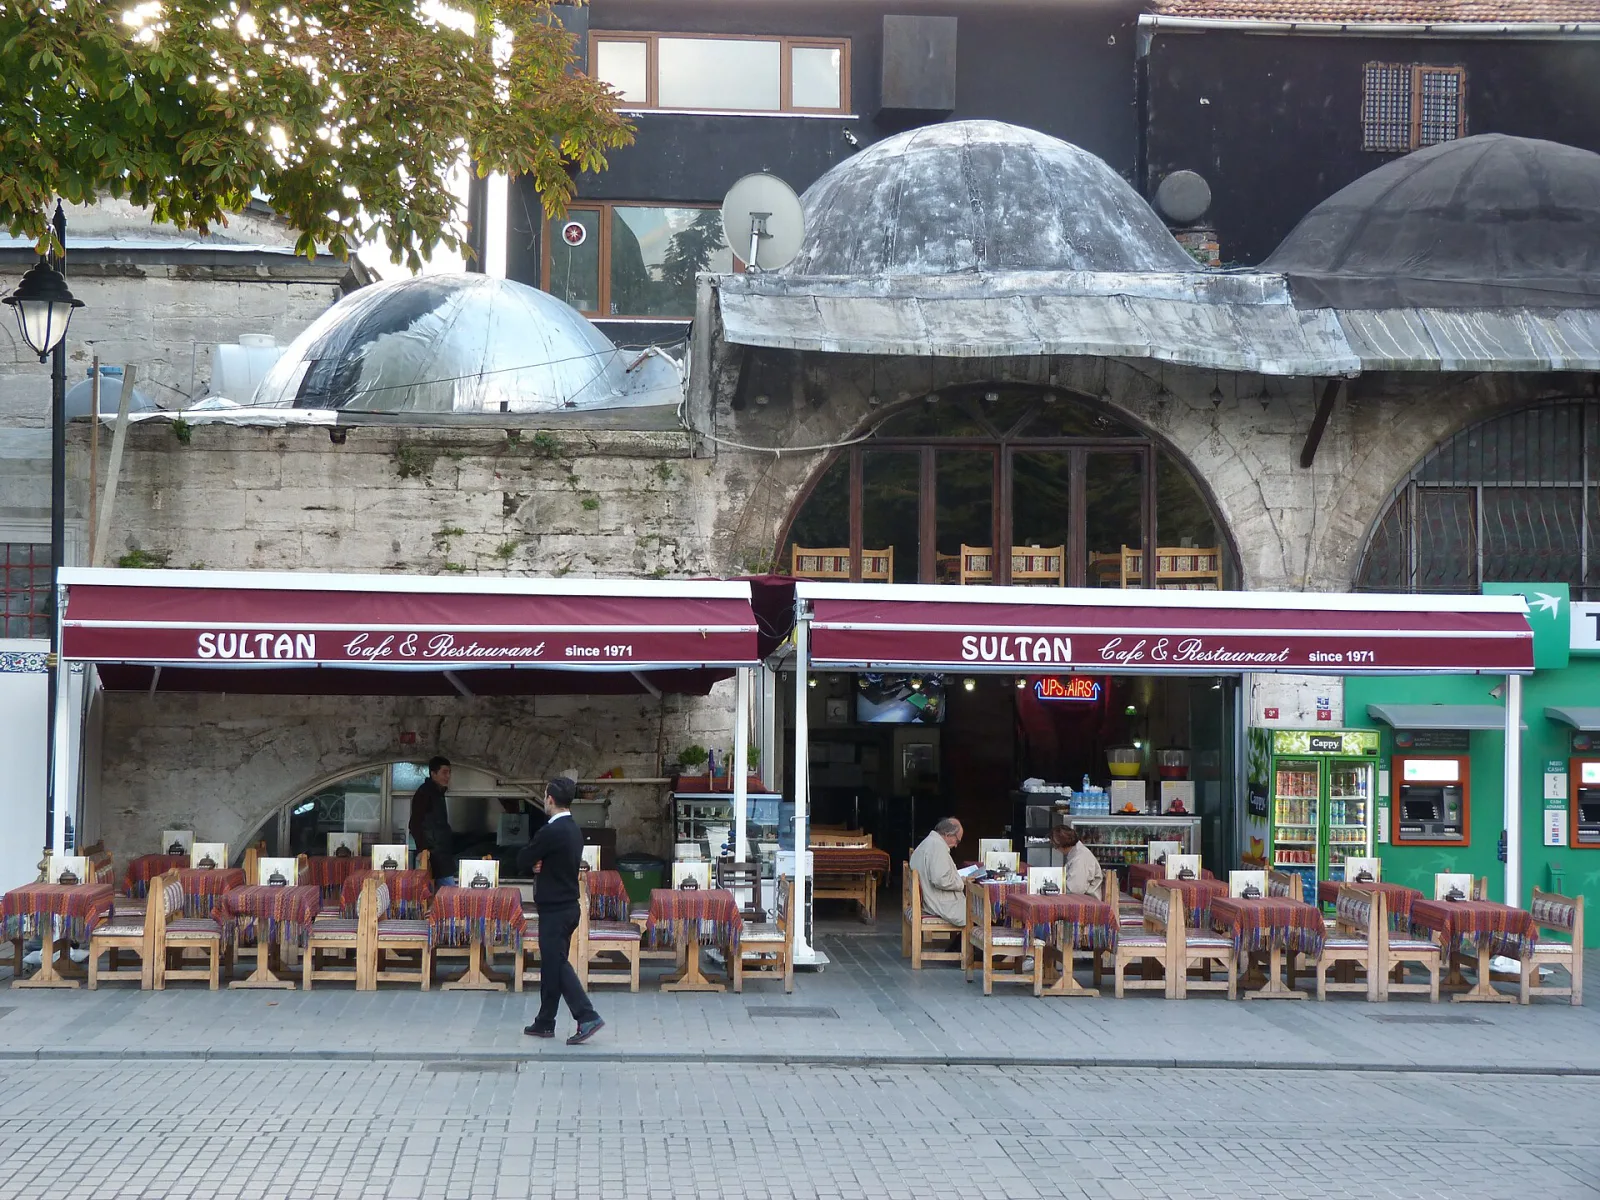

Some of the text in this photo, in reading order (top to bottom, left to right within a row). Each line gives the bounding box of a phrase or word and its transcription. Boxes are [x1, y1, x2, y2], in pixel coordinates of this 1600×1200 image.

[197, 632, 633, 661] SULTAN Cafe & Restaurant since 1971
[961, 635, 1374, 664] SULTAN Cafe & Restaurant since 1971
[1312, 739, 1340, 749] Cappy
